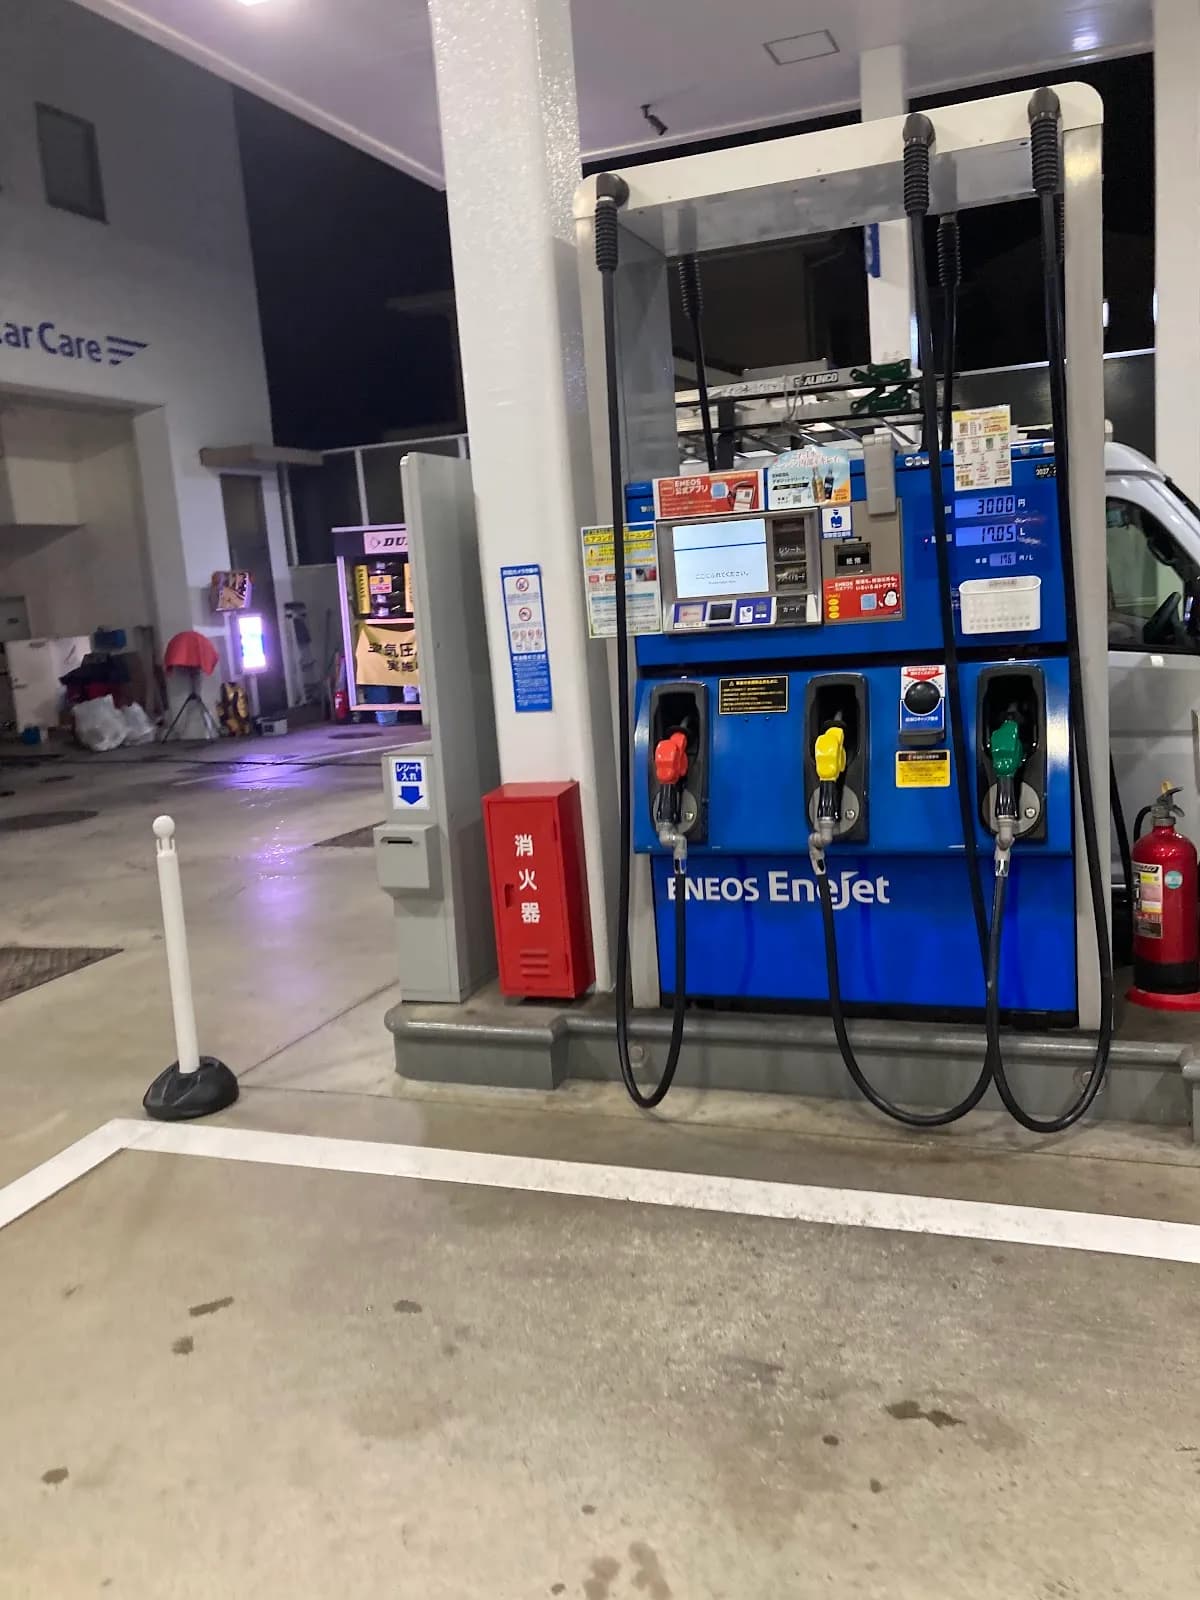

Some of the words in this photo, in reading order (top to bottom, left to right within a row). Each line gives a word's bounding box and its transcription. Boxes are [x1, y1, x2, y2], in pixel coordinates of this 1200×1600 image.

[0, 322, 33, 349] ar
[38, 321, 102, 362] Care
[675, 479, 702, 487] ENEOS
[976, 496, 1015, 515] 3000
[1019, 527, 1026, 536] L
[383, 536, 408, 548] DU
[396, 763, 421, 772] レシート
[401, 772, 417, 781] 入れ
[514, 833, 541, 924] 消火器
[667, 877, 760, 901] ENEOS
